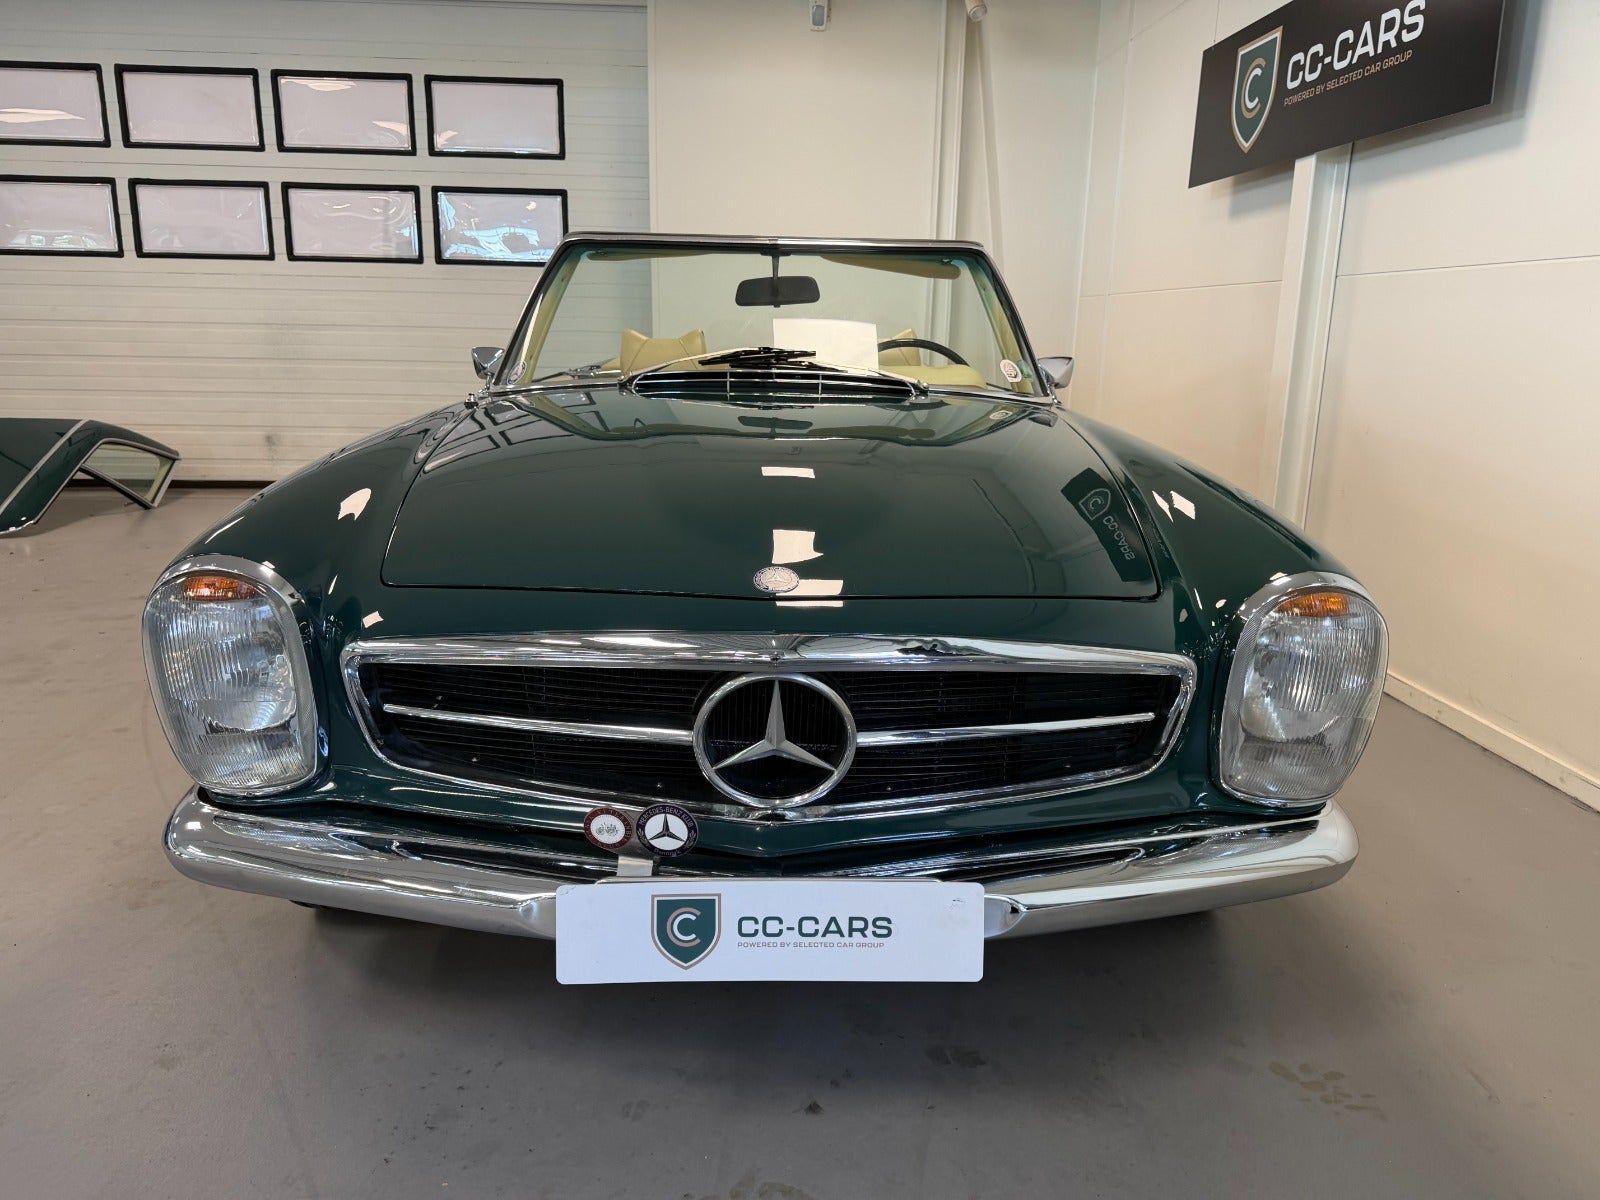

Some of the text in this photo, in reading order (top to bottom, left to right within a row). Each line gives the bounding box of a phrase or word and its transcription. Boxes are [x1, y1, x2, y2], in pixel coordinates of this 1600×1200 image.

[1286, 0, 1426, 90] CC-CARS
[1283, 49, 1413, 106] POWERED BY SELECTED CAR GROUP
[737, 915, 893, 939] CC-CARS
[737, 941, 777, 949] POWERED
[779, 941, 791, 949] BY
[792, 941, 835, 949] SELECTED
